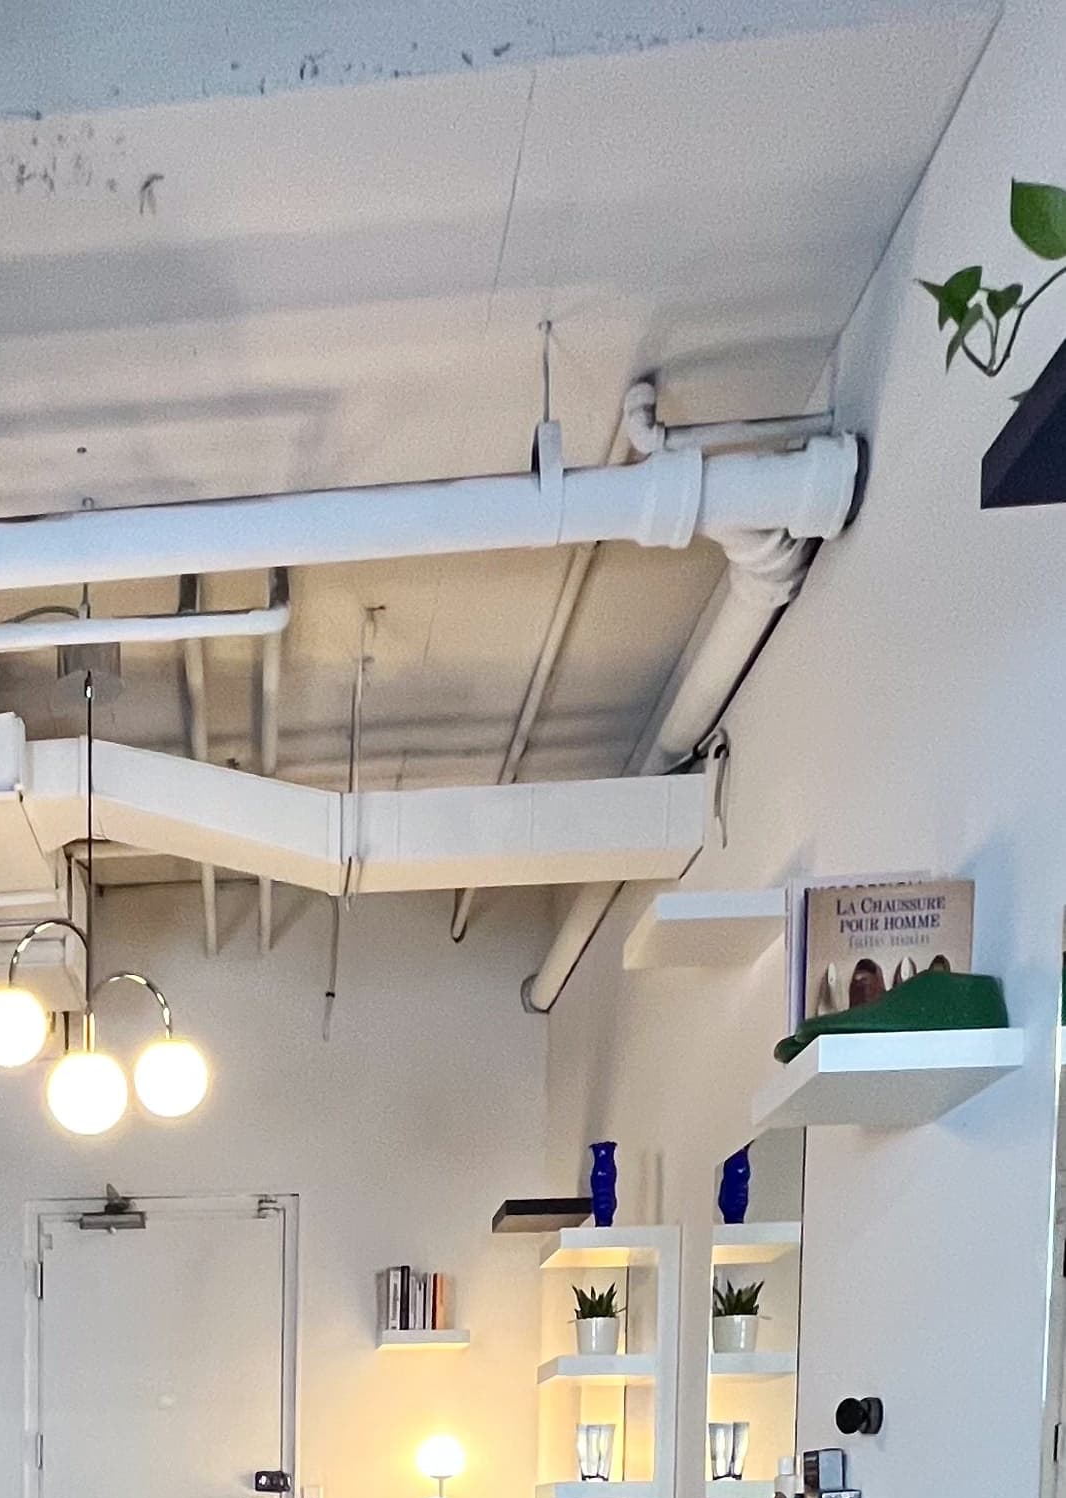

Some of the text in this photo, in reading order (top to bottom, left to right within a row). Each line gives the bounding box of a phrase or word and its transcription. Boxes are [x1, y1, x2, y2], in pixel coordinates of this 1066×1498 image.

[836, 896, 947, 916] LA CHAUSSURE
[839, 914, 941, 934] POUR HOMME
